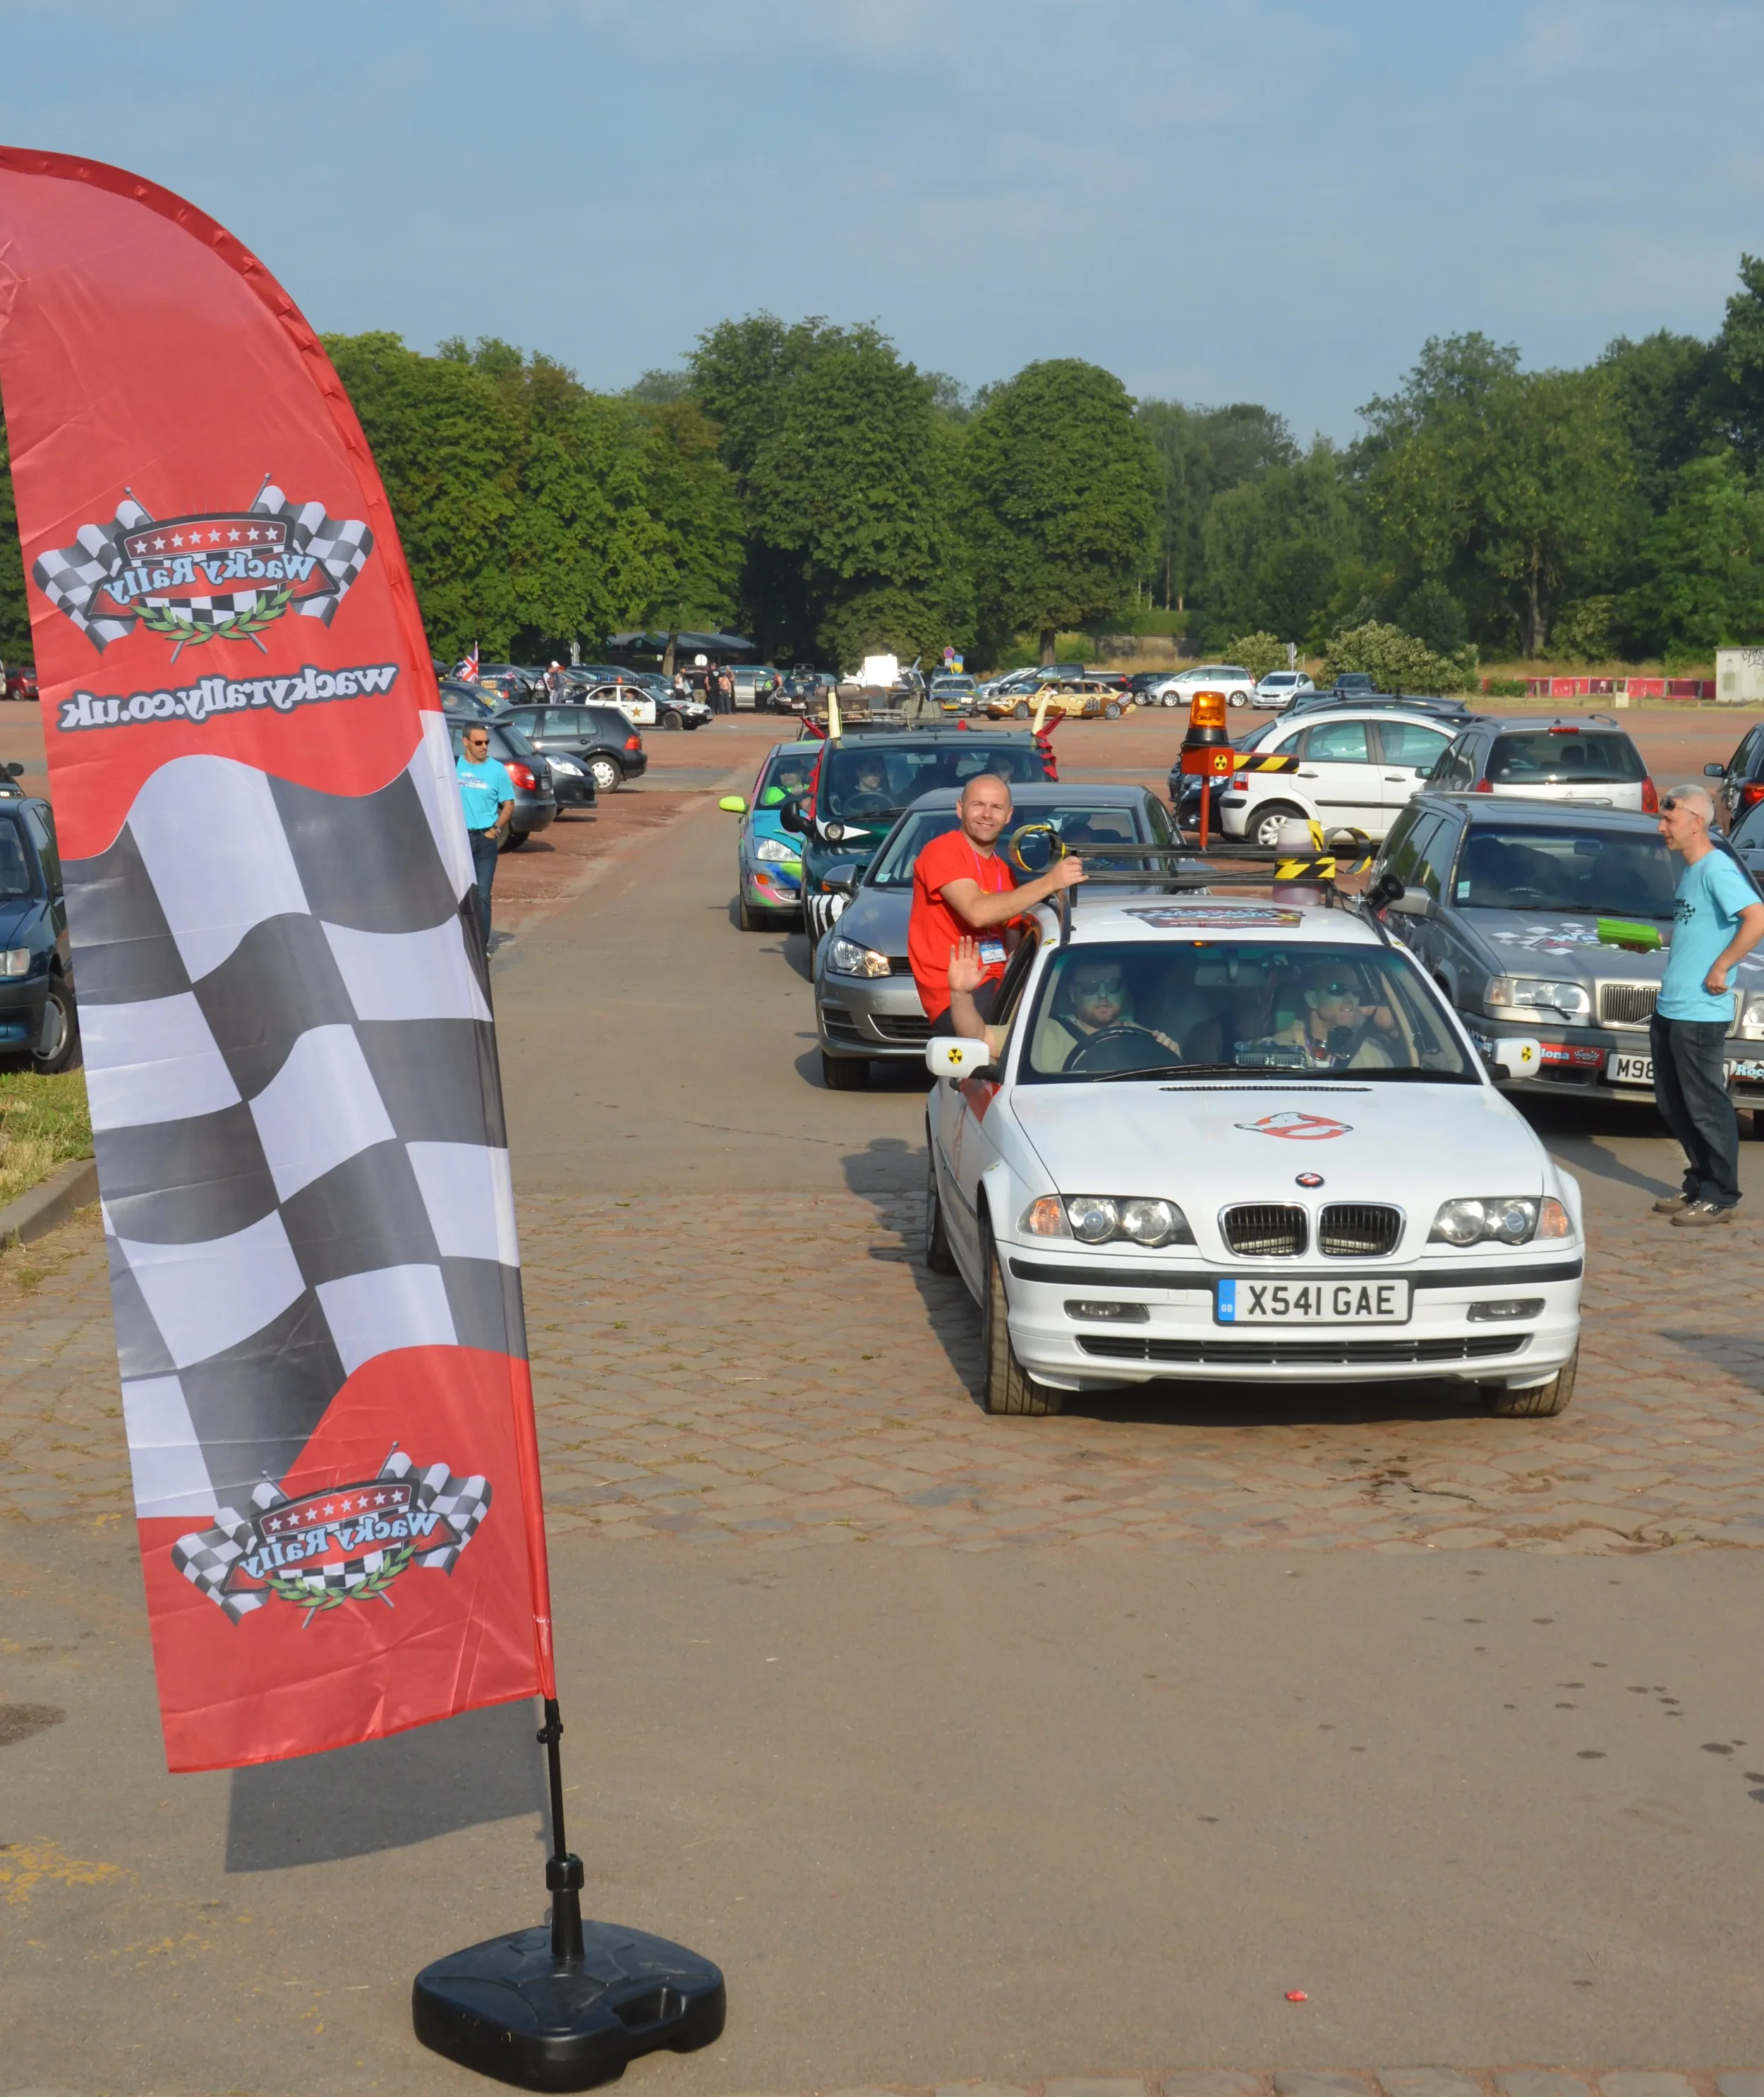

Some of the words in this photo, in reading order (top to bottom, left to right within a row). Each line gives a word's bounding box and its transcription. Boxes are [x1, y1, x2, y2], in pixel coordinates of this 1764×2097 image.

[1221, 1304, 1233, 1312] GB
[1248, 1286, 1322, 1316] X541
[1333, 1286, 1395, 1316] GAE
